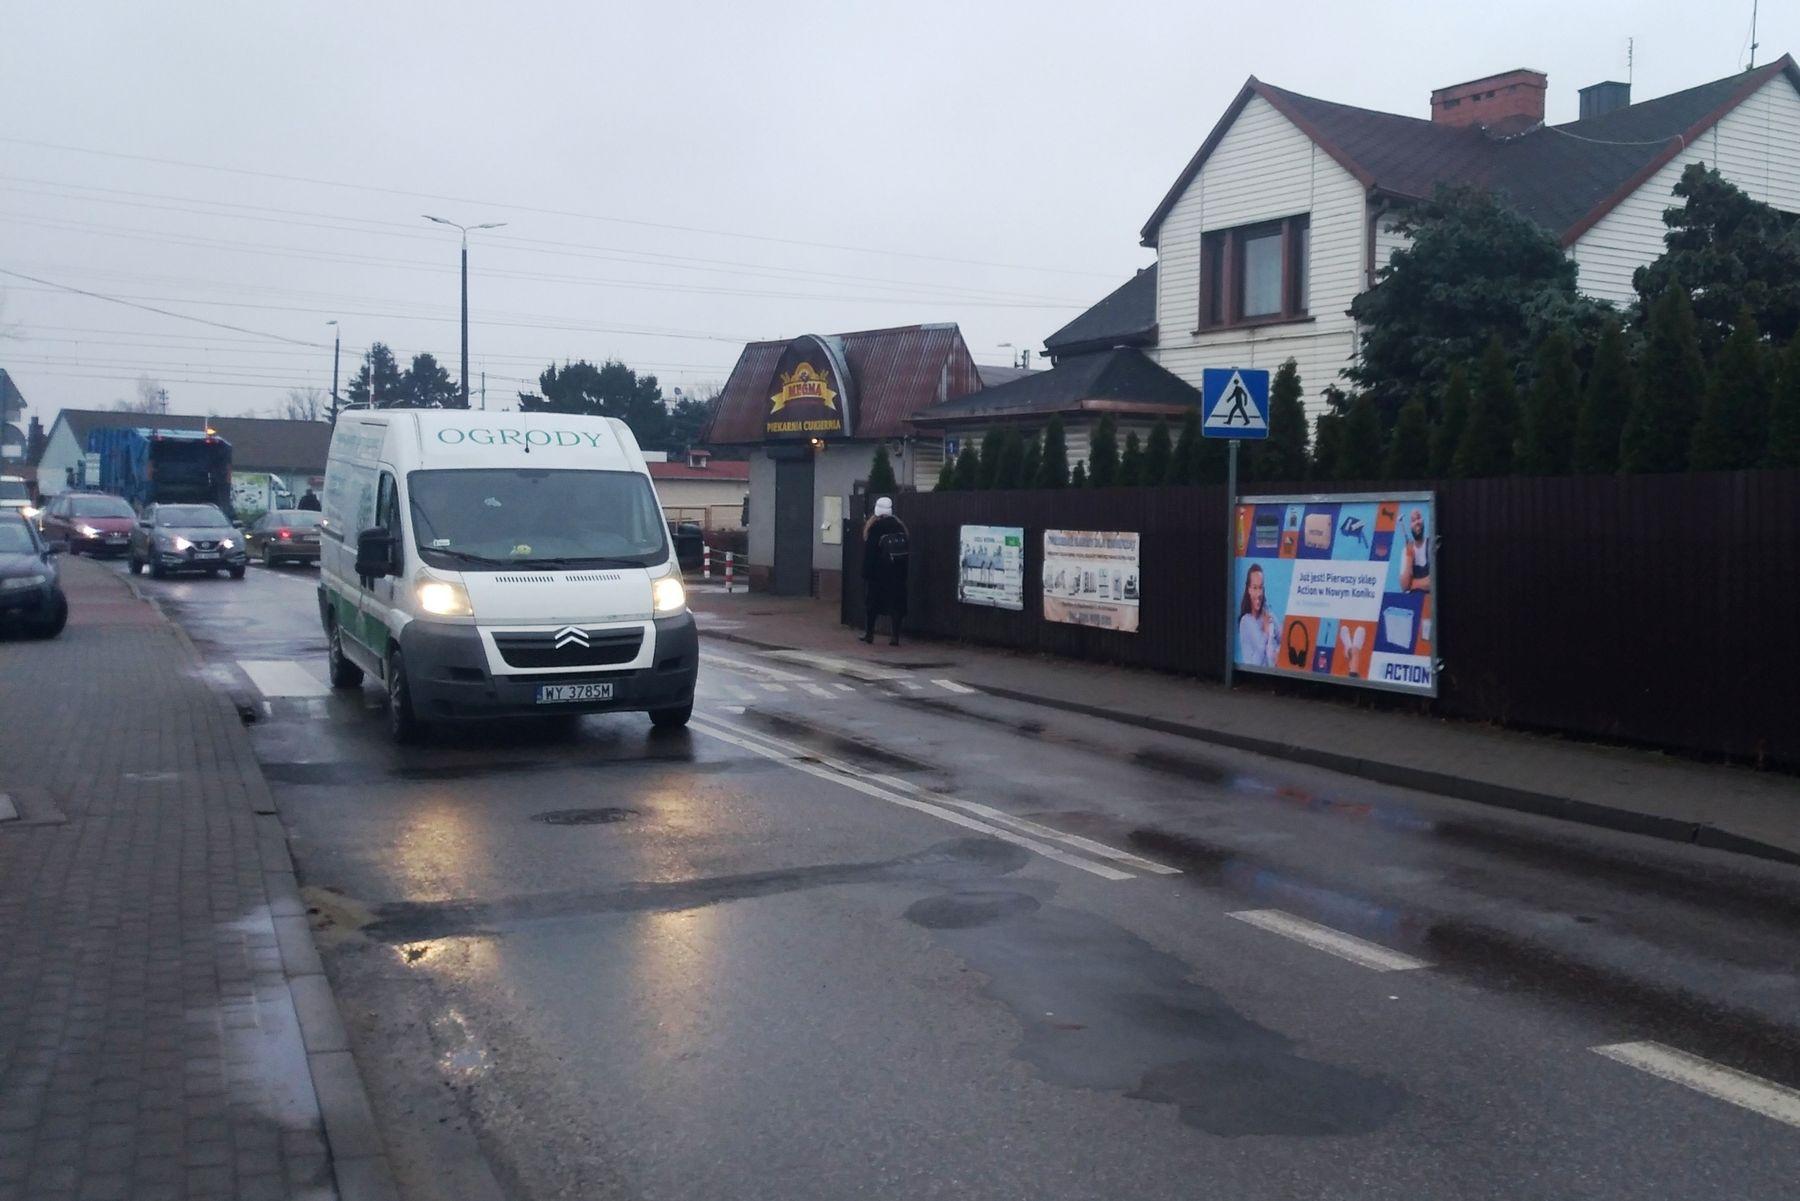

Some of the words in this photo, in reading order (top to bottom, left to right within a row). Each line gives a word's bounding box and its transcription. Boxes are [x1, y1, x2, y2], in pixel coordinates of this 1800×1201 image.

[767, 421, 802, 433] PIEKARNIA
[803, 419, 841, 431] CUKIERNIA
[437, 428, 602, 447] OGRODY
[1299, 572, 1310, 582] Już
[1326, 573, 1356, 585] Pierwszy
[1357, 573, 1377, 585] sklep
[1297, 585, 1317, 595] Action
[1325, 587, 1350, 599] Nowym
[1384, 662, 1430, 684] ACTION
[545, 686, 563, 700] WY
[568, 685, 611, 698] 3785M
